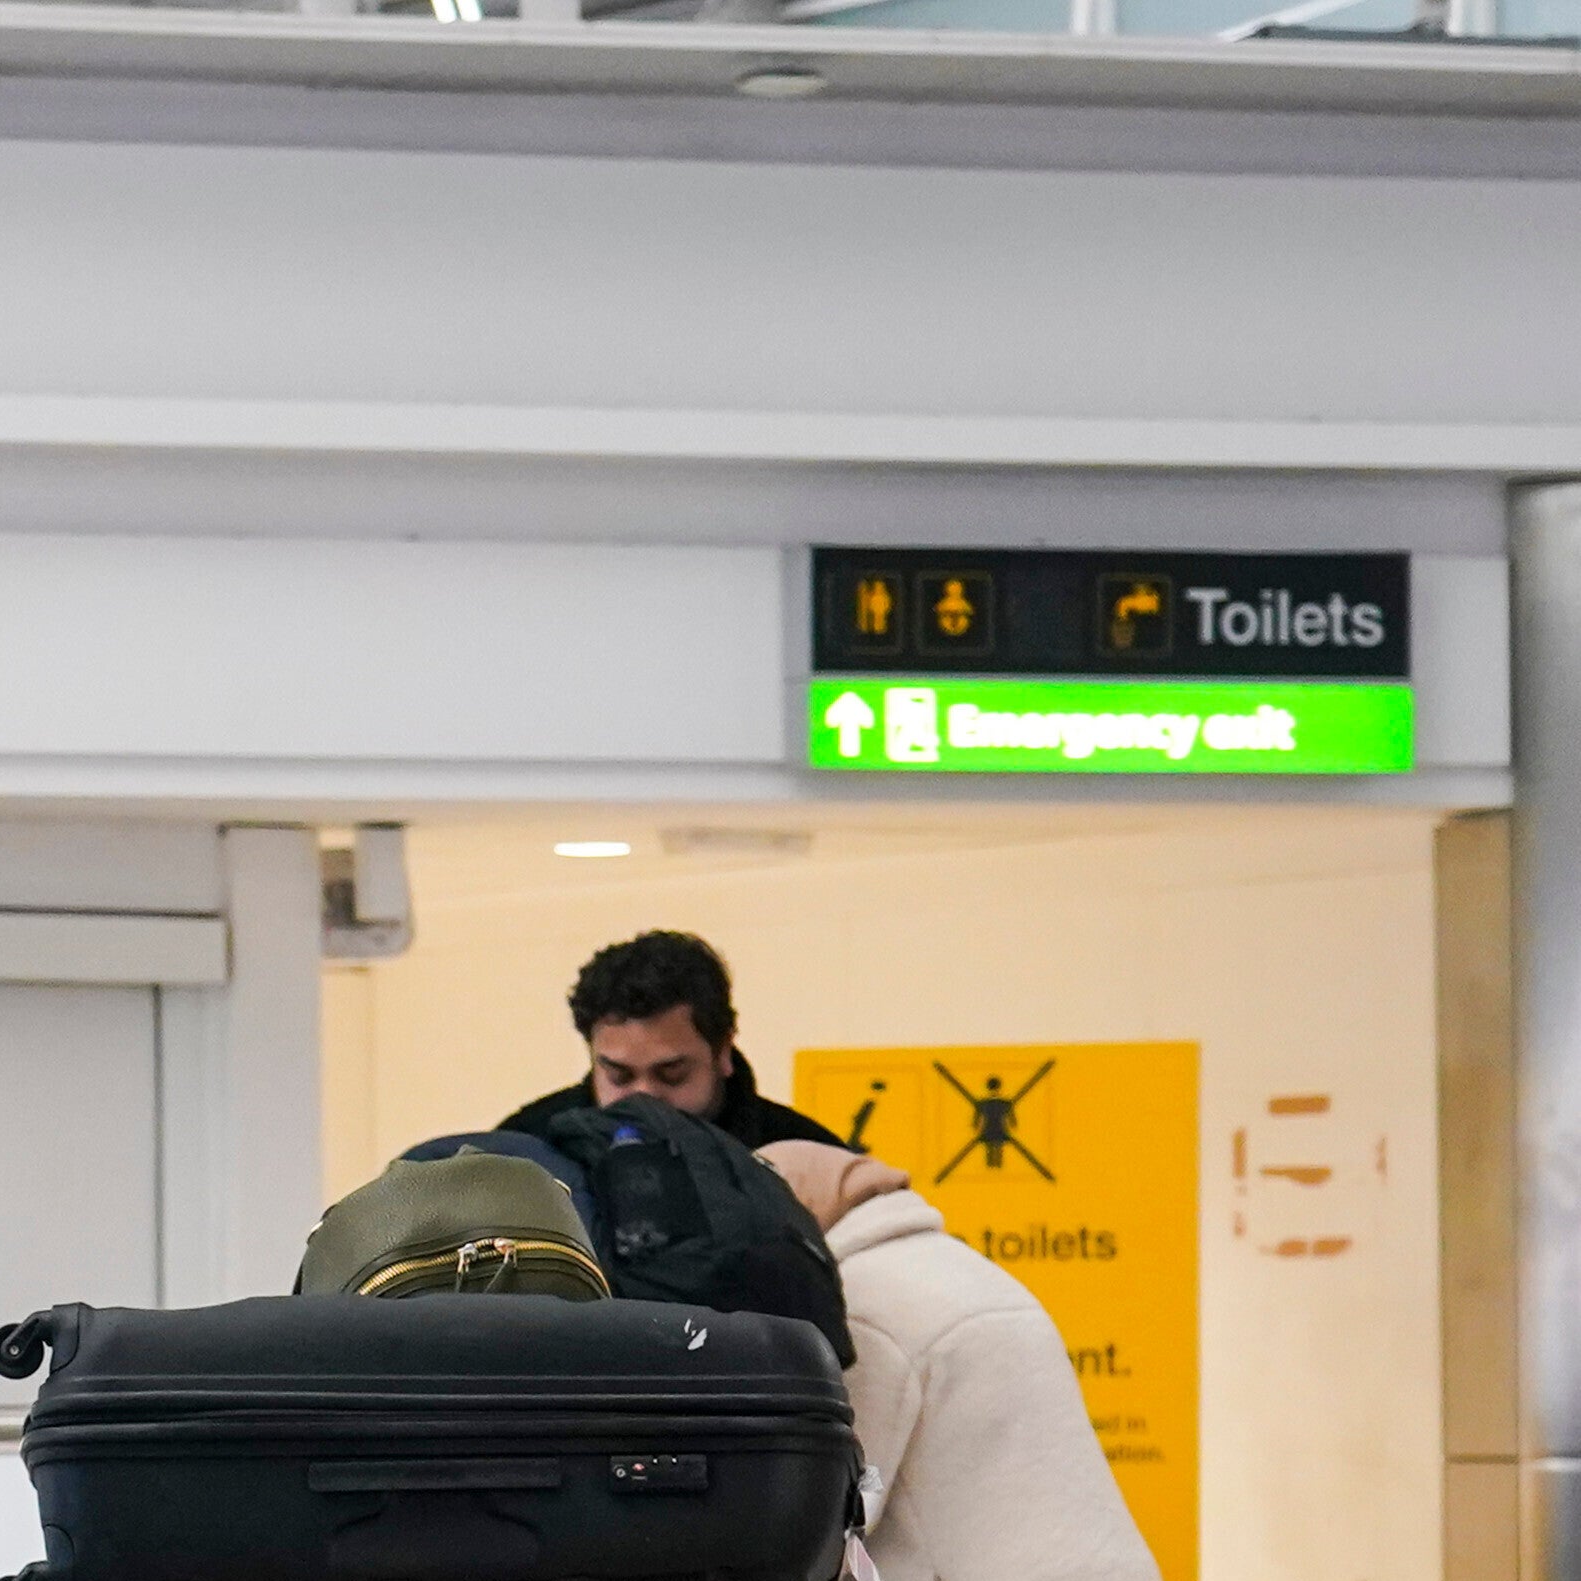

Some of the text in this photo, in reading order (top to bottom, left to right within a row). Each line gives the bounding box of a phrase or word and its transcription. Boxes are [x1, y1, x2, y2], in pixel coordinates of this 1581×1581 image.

[1186, 586, 1385, 647] Toilets
[947, 702, 1296, 759] Emergency exit
[981, 1223, 1119, 1262] toilets
